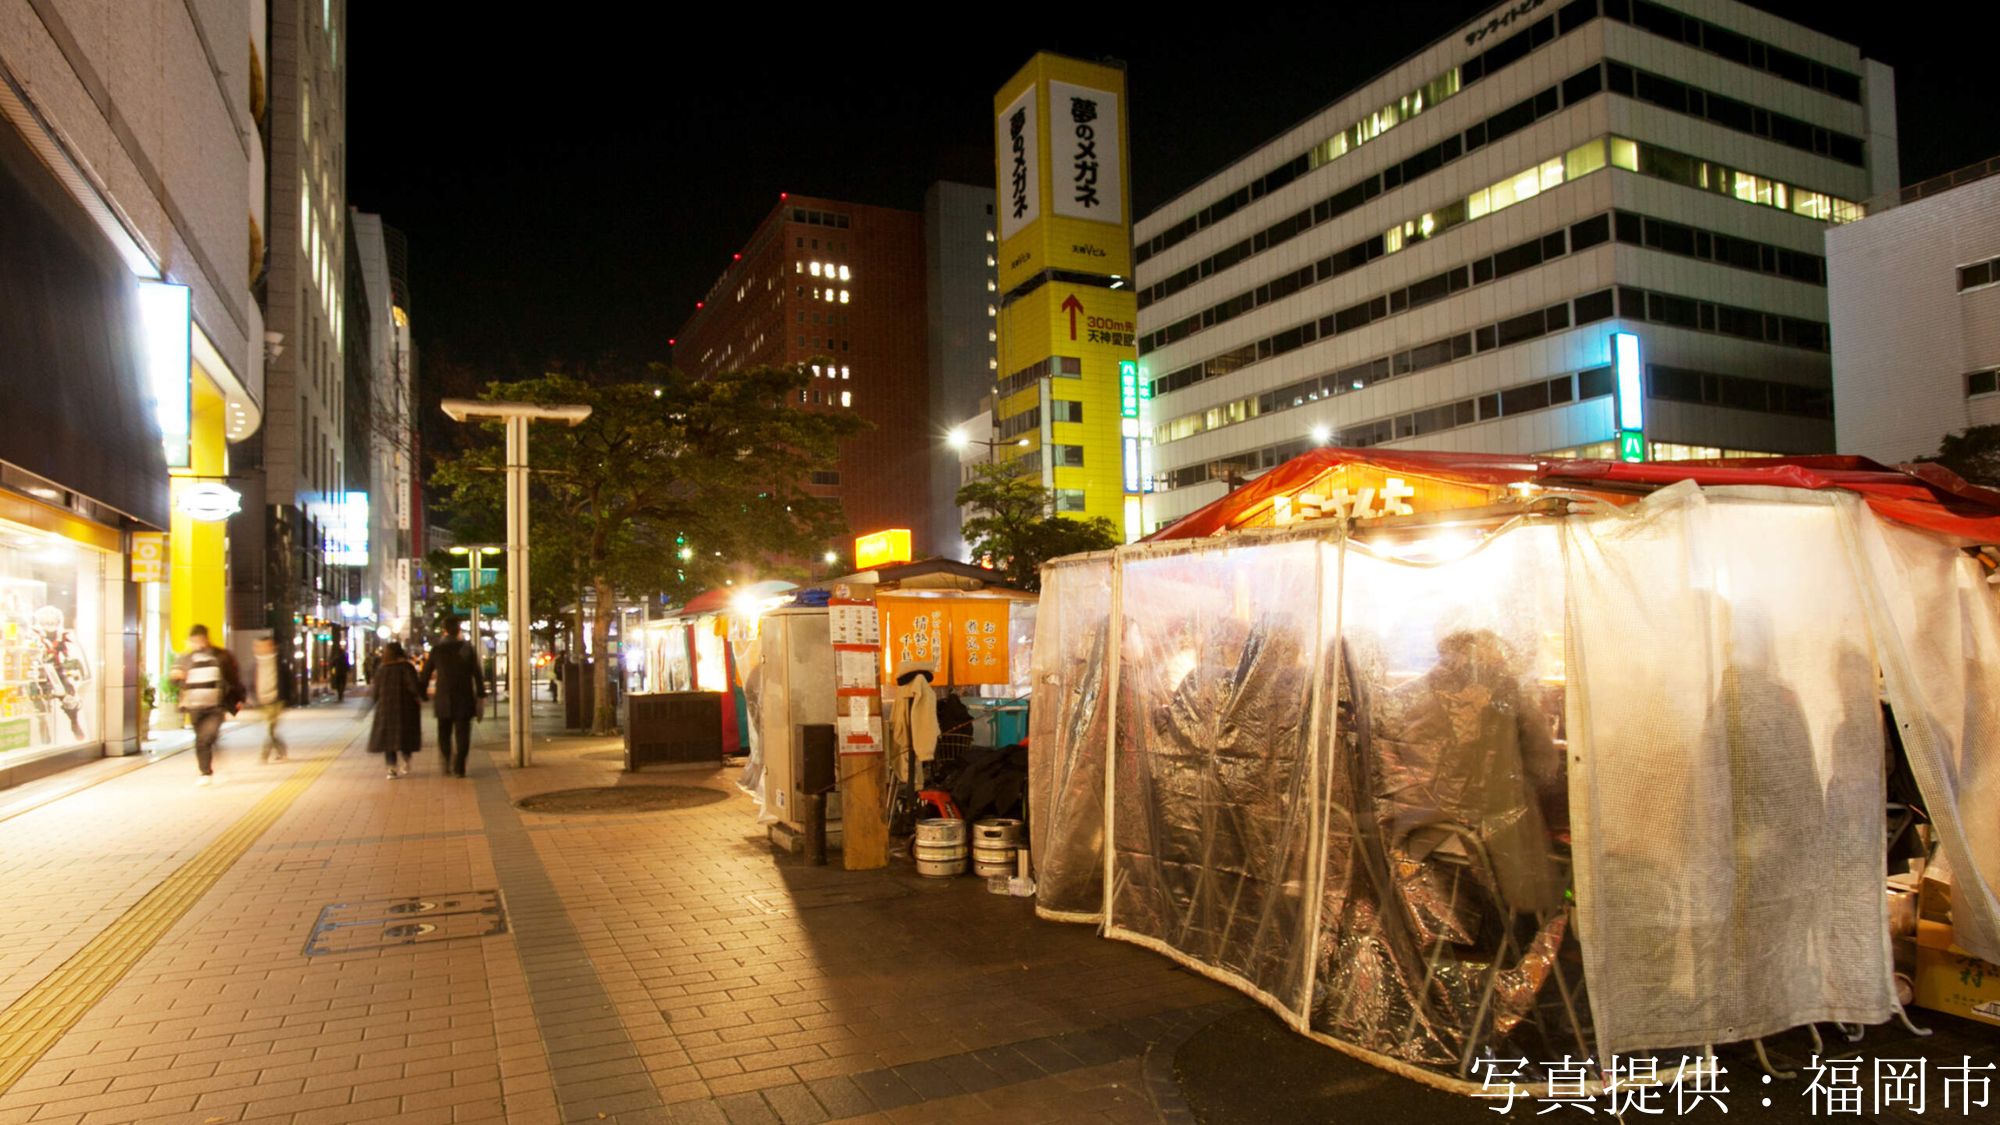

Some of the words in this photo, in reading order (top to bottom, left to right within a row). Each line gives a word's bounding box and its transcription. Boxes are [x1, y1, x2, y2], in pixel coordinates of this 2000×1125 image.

[1009, 106, 1028, 218] 夢のメガネ
[1070, 96, 1100, 208] 夢のメガネ
[1087, 316, 1135, 333] 300m先
[913, 615, 929, 658] 情熱の
[965, 619, 981, 666] 煮込み
[983, 621, 997, 666] おでん
